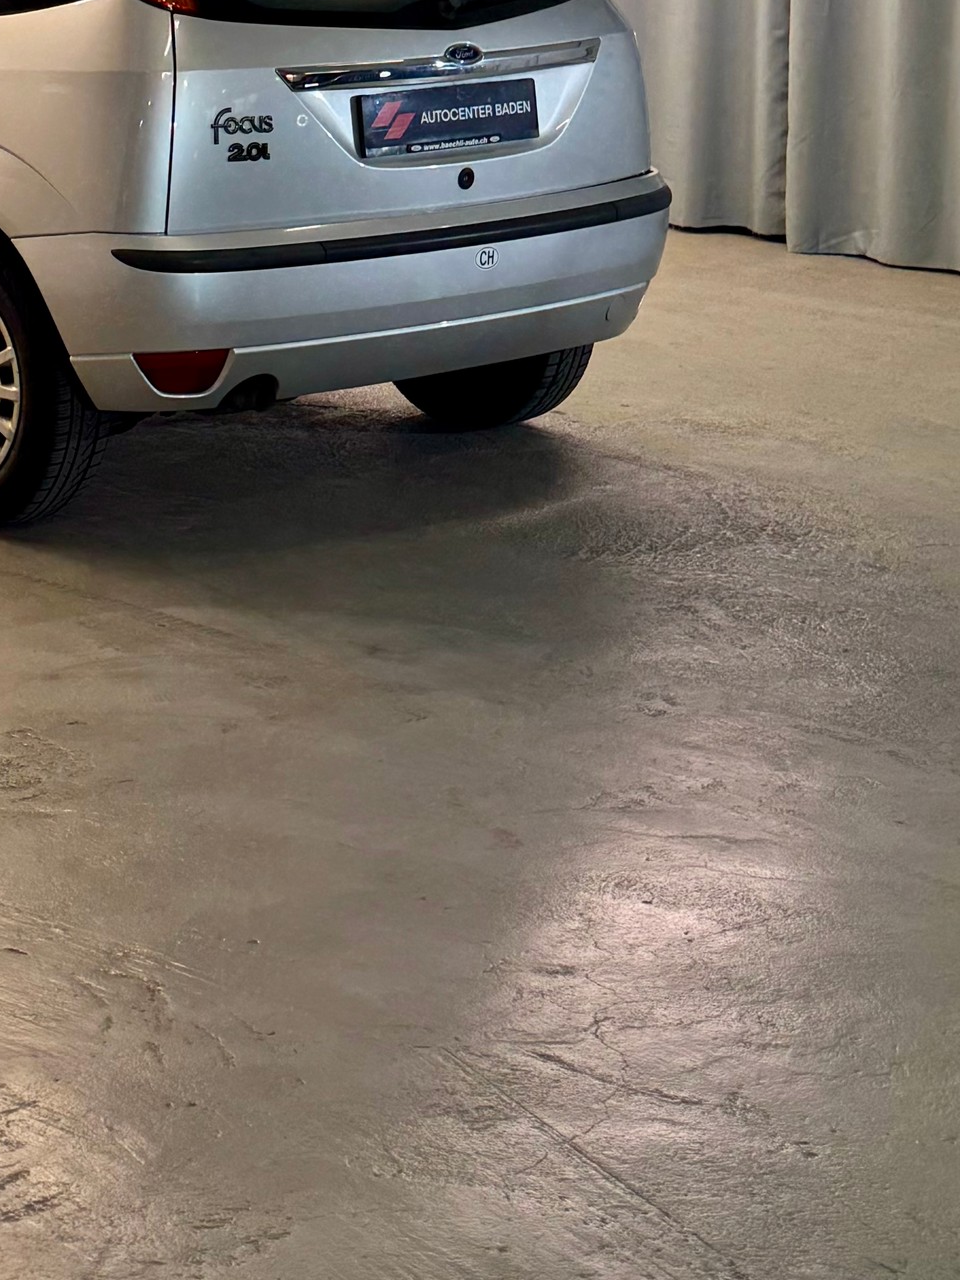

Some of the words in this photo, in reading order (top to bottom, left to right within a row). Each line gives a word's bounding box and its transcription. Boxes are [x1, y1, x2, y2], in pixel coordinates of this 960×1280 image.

[420, 105, 492, 124] AUTOCENTER
[495, 101, 531, 116] BADEN
[479, 250, 495, 266] CH
